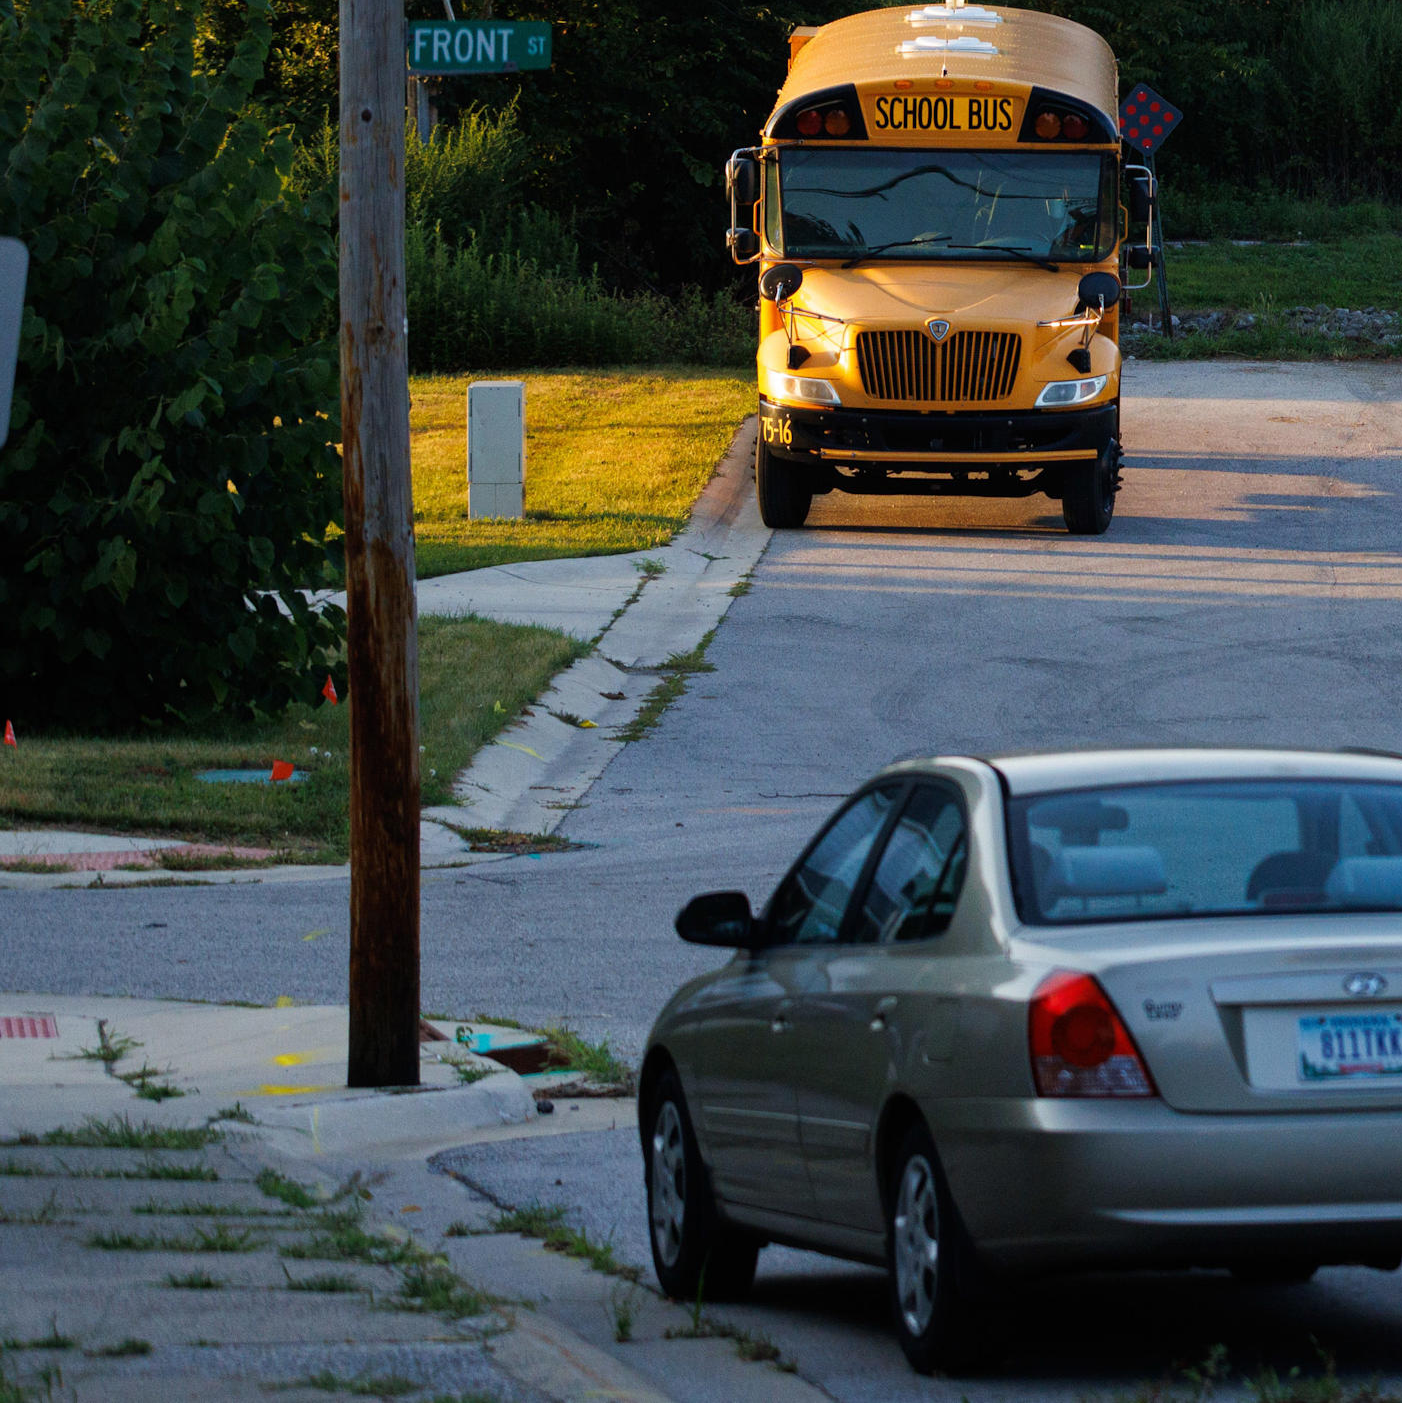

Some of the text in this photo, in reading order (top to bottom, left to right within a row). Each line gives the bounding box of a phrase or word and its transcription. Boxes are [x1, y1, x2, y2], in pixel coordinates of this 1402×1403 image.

[414, 28, 547, 63] FRONT ST
[875, 96, 1012, 131] SCHOOL BUS
[761, 416, 793, 445] 75-16
